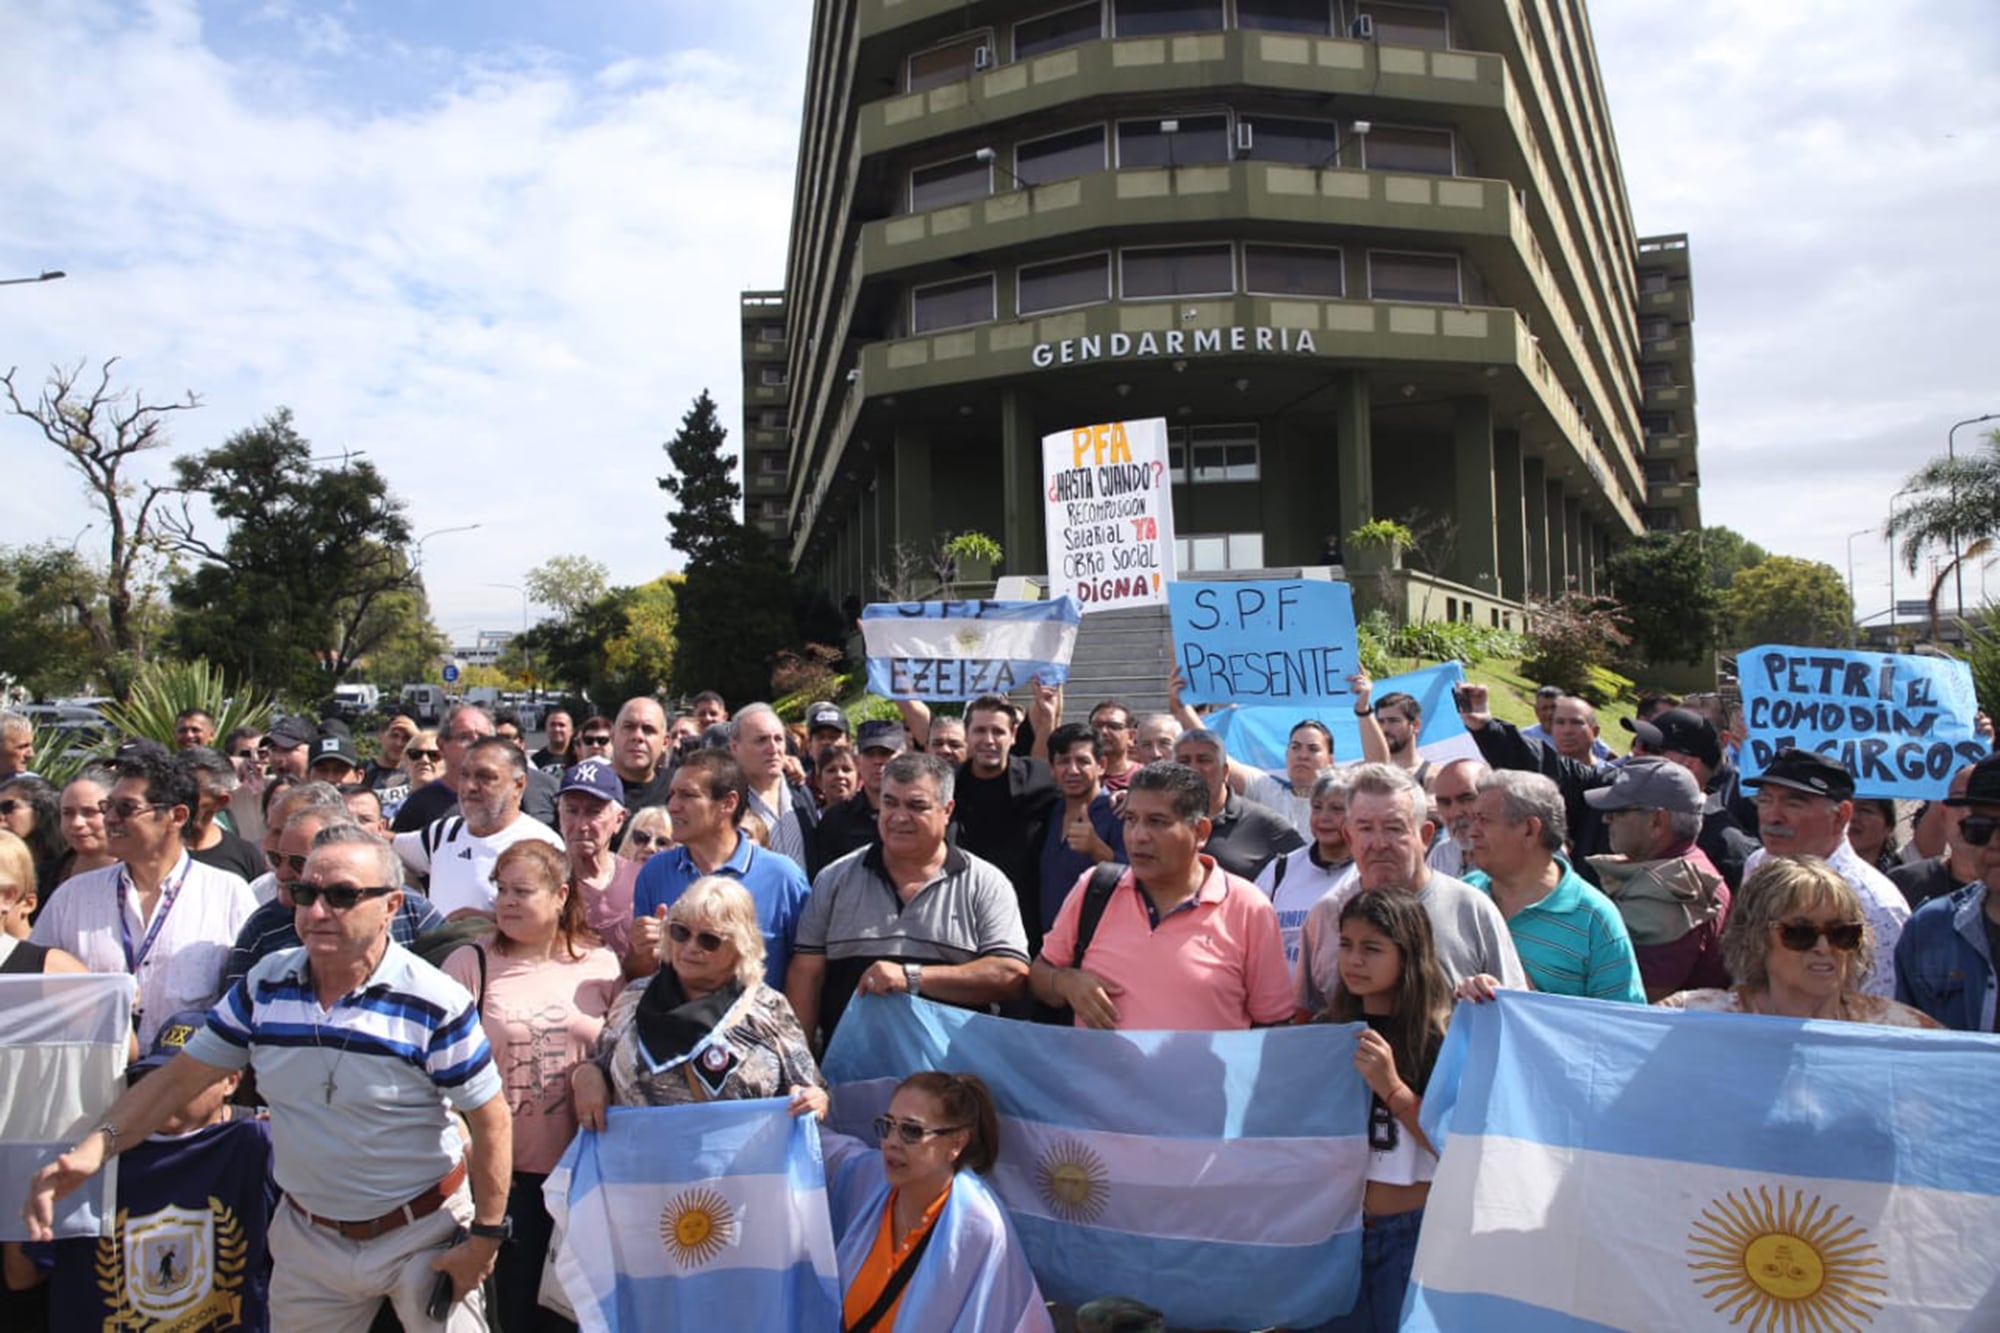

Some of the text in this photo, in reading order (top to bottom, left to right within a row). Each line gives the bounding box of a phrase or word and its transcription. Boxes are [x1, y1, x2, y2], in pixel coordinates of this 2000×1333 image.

[1032, 327, 1317, 368] GENDARMERIA
[1072, 421, 1132, 468] PFA
[1098, 461, 1164, 497] CUANDO?
[890, 658, 1015, 695] EZEIZA
[1184, 643, 1348, 696] PRESENTE
[1906, 678, 1938, 707] EL
[574, 764, 599, 782] NY
